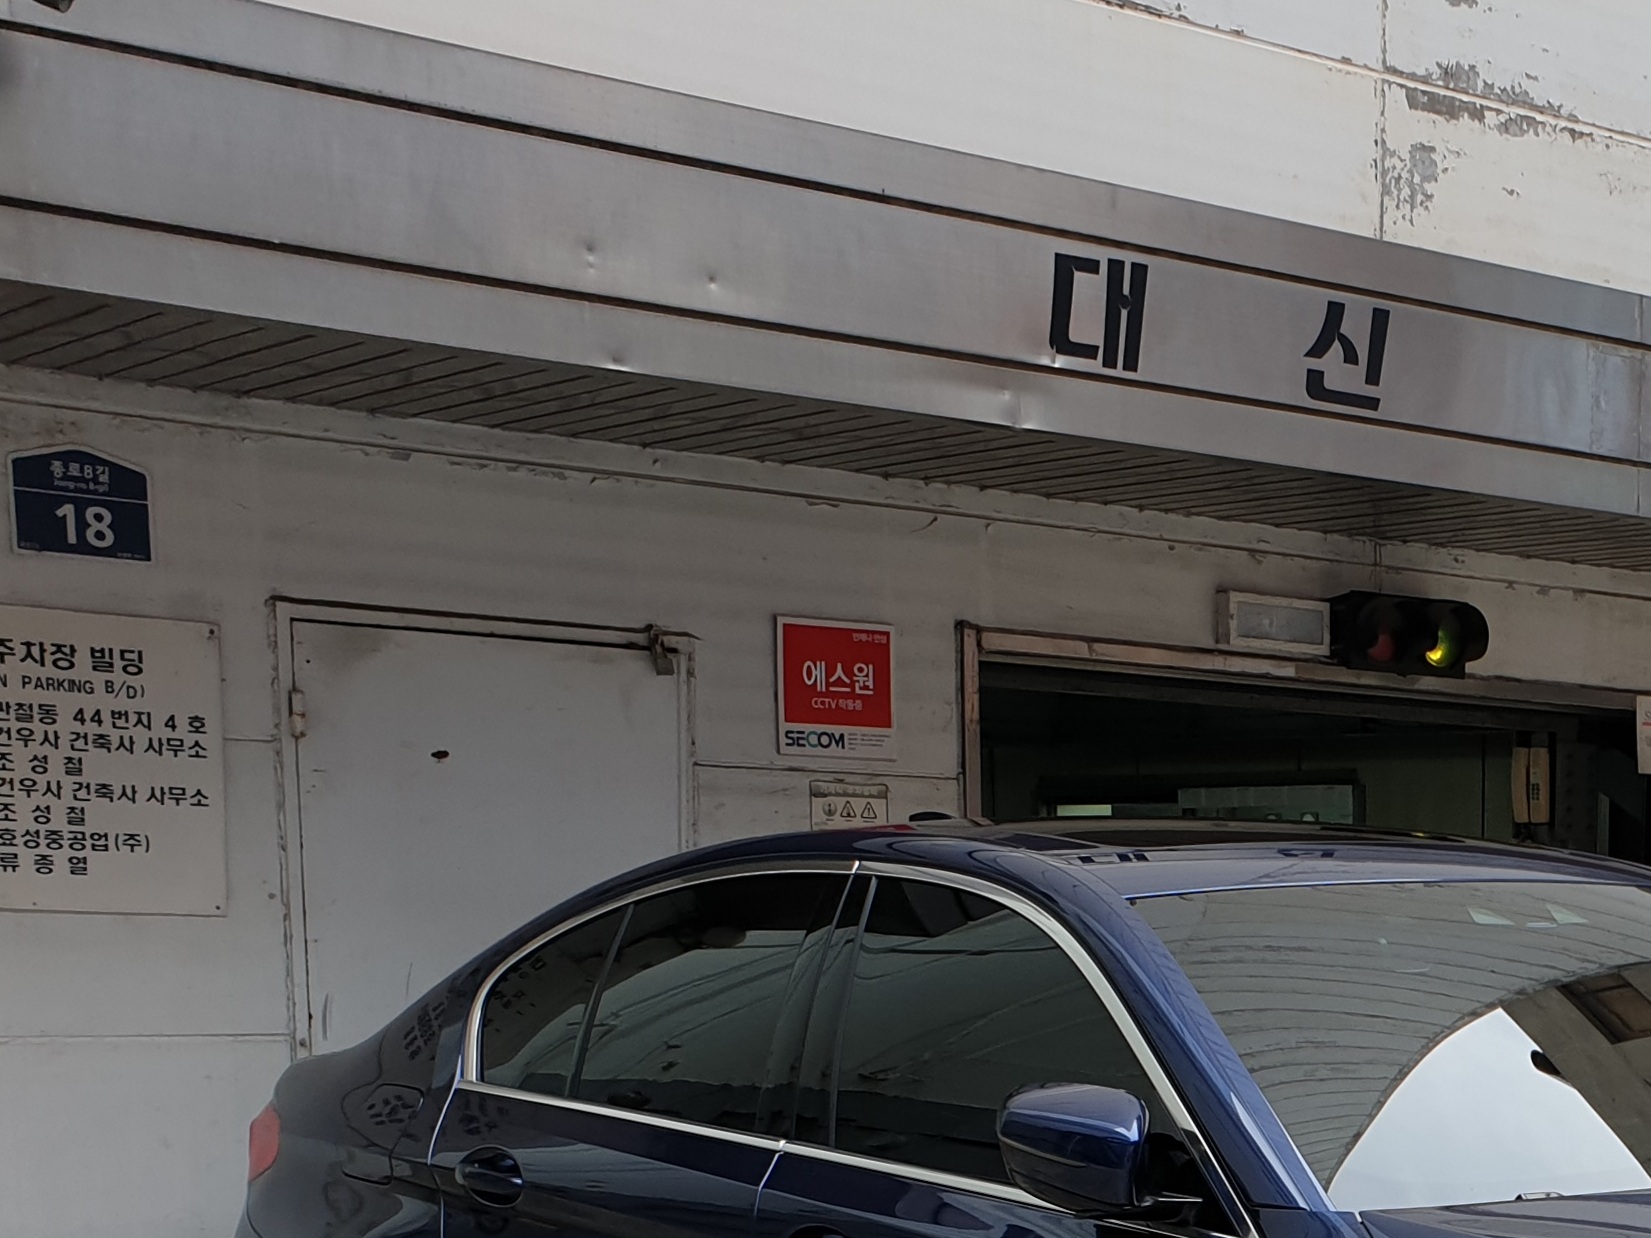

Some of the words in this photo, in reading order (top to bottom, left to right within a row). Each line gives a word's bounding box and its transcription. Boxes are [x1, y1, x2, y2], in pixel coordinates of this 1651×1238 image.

[50, 459, 110, 484] 종로8길
[55, 502, 115, 548] 18
[90, 646, 144, 677] 빌딩
[22, 675, 95, 695] PARKING
[802, 660, 875, 695] 에스원
[811, 697, 838, 710] CCTV
[69, 731, 135, 754] 건축사
[144, 736, 208, 759] 사무소
[784, 730, 845, 750] SECOM
[71, 781, 137, 804] 건축사
[146, 785, 210, 808] 사무소
